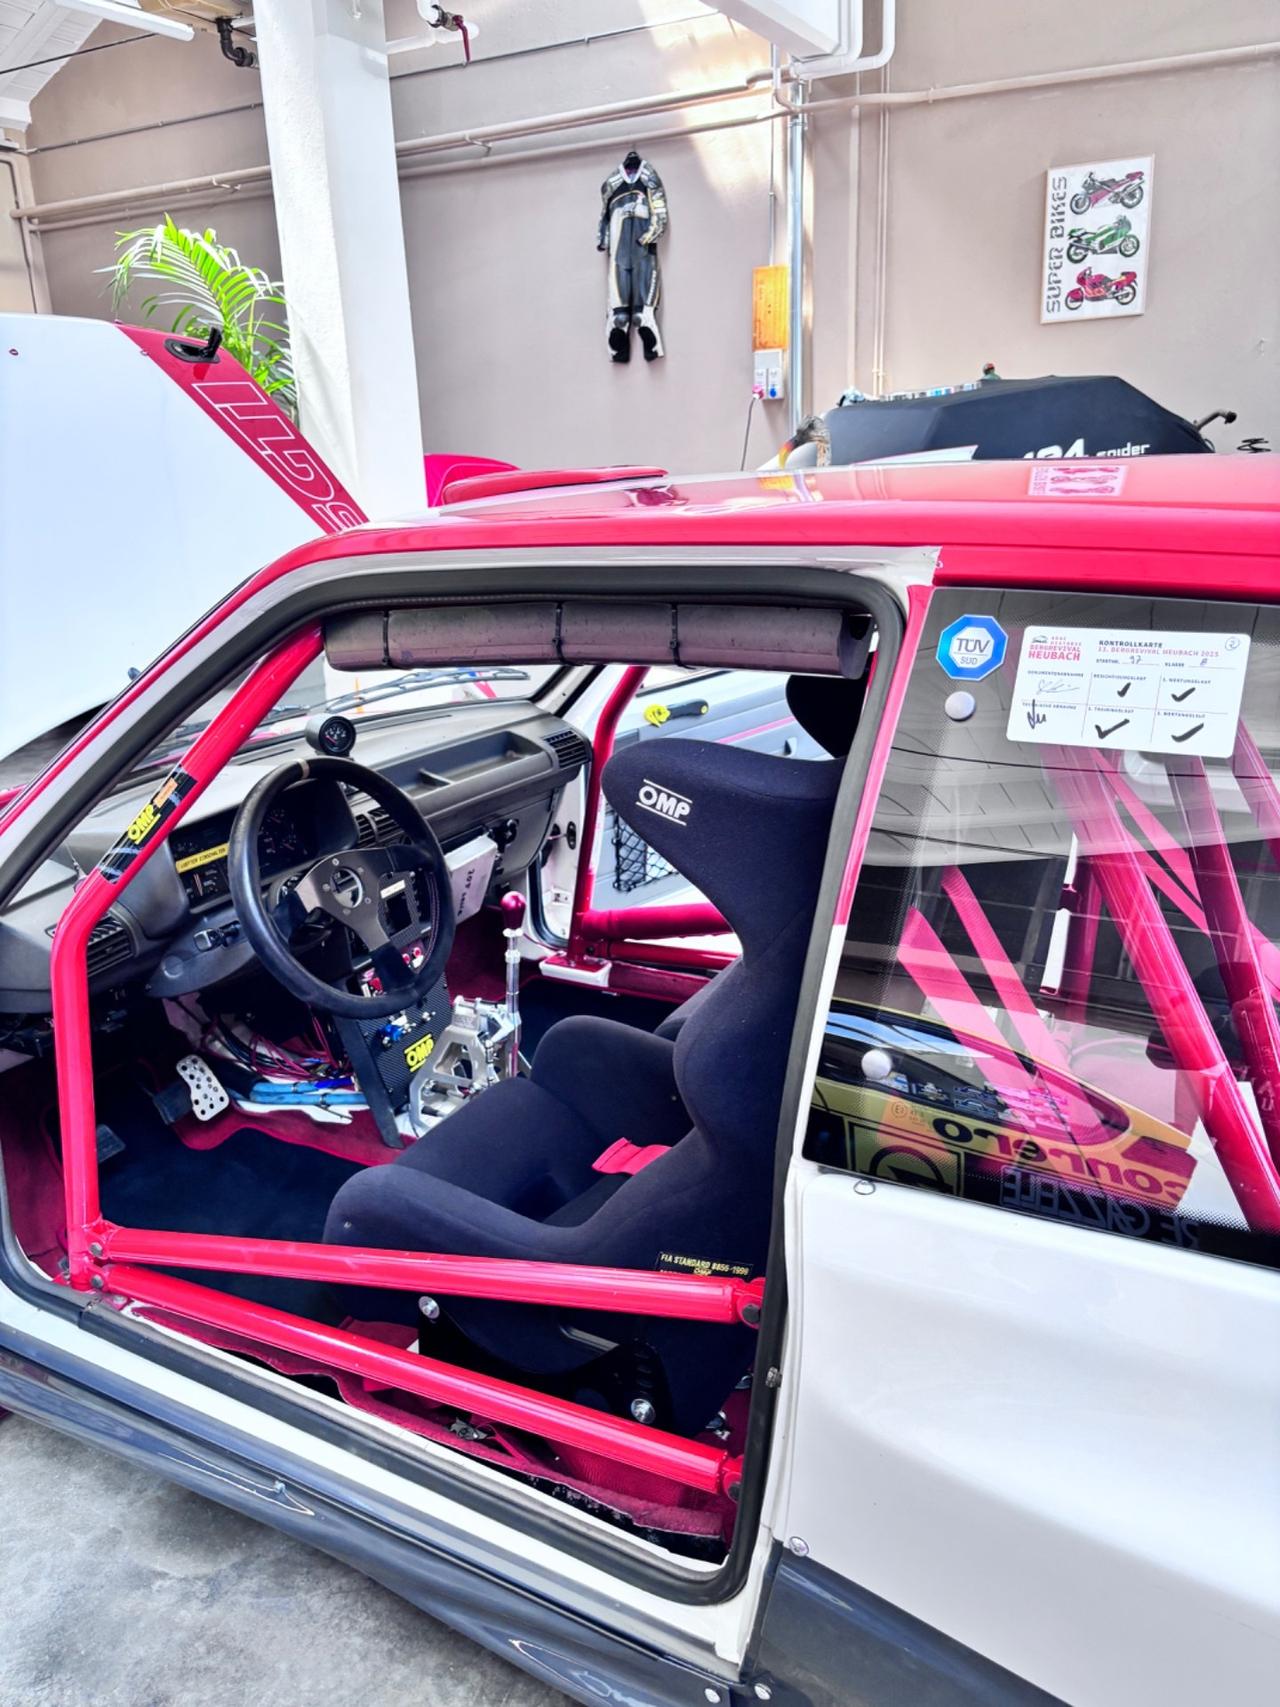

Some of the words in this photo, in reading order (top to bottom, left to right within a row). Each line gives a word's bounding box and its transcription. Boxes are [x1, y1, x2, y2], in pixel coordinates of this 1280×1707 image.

[1050, 176, 1067, 239] BIKES
[1046, 247, 1064, 313] SUPER
[956, 637, 991, 654] TÜV
[1028, 650, 1081, 662] HEUBACH
[1099, 640, 1163, 649] KONTROLLKARTE
[638, 785, 691, 819] OMP
[128, 804, 155, 841] OMP
[405, 1037, 435, 1067] OMP
[660, 1253, 674, 1263] FIA
[673, 1255, 711, 1269] STANDARD
